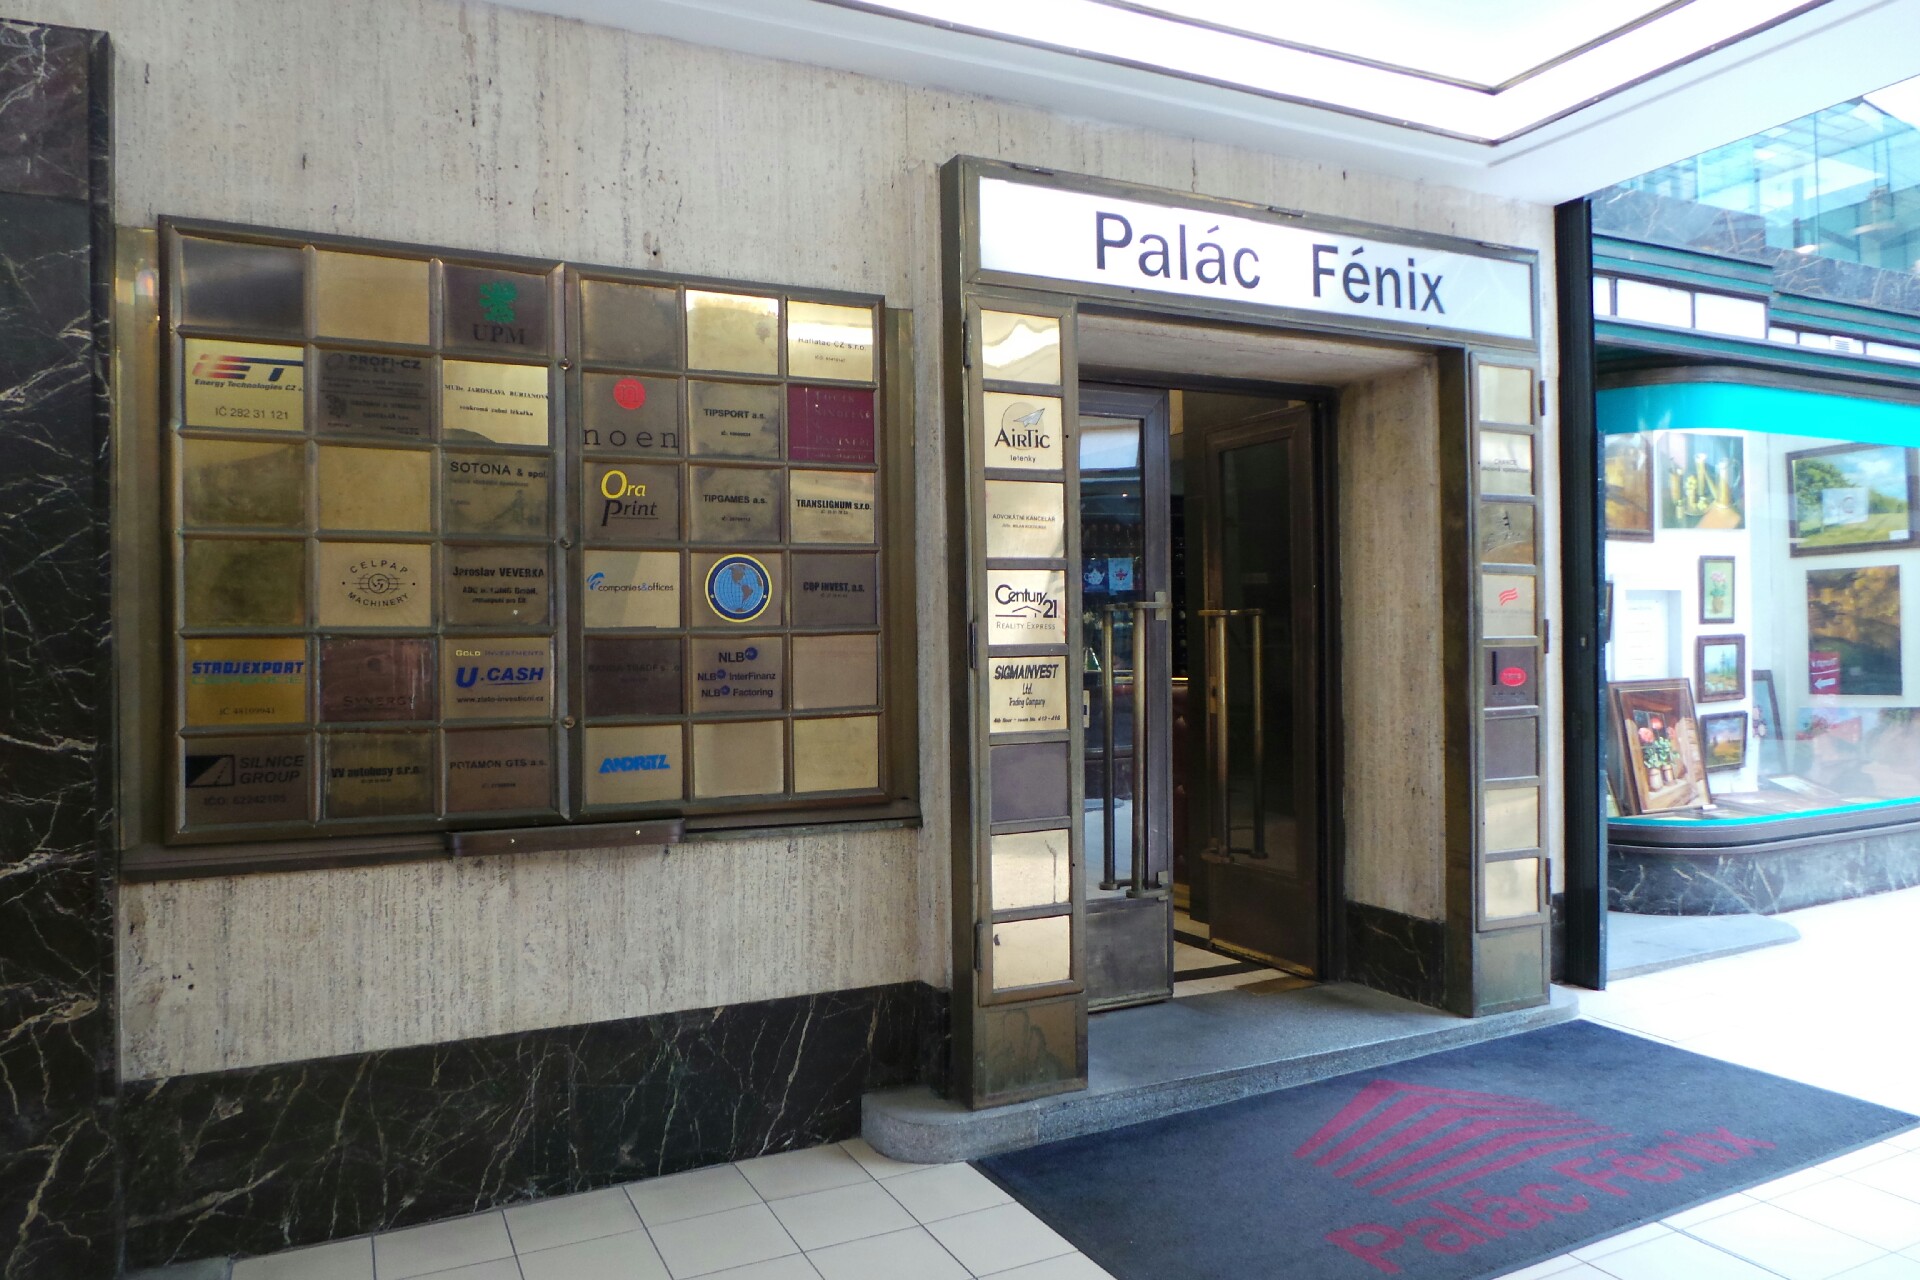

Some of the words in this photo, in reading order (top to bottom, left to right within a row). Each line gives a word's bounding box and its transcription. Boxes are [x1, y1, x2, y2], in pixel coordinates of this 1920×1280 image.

[1095, 211, 1261, 290] Palác
[1312, 244, 1446, 314] Fénix
[472, 323, 526, 345] UPM
[349, 355, 421, 369] PROFI-CZ
[194, 379, 225, 388] Energy
[227, 381, 283, 391] Technologies
[467, 387, 506, 396] JAROSLAVA
[230, 408, 250, 418] 282
[253, 409, 265, 419] 31
[271, 410, 289, 420] 121
[703, 408, 750, 418] TIPSPORT
[583, 428, 679, 449] noen
[1010, 454, 1037, 464] letenky
[450, 461, 511, 475] SOTONA
[516, 468, 523, 477] &
[600, 469, 647, 499] Ora
[703, 494, 750, 503] TIPGAMES
[796, 499, 852, 509] TRANSLIGNUM
[854, 502, 872, 511] s.r.o.
[601, 499, 659, 527] Print
[350, 559, 409, 574] CELPAP
[452, 566, 496, 576] Jaroslav
[499, 567, 544, 578] VEVERKA
[597, 583, 674, 593] companies&offices
[348, 592, 409, 607] MACHINERY
[995, 584, 1048, 605] Century
[1043, 599, 1057, 618] 21
[996, 621, 1024, 629] REALITY
[1027, 622, 1056, 630] EXPRESS
[455, 649, 481, 657] GOLD
[718, 651, 744, 663] NLB
[192, 661, 304, 675] STROJEXPORT
[994, 664, 1059, 680] SIGMAINVEST
[698, 672, 717, 681] NLB
[729, 671, 776, 681] InterFinanz
[701, 688, 720, 697] NLB
[732, 687, 773, 698] Factoring
[1022, 683, 1033, 695] Ltd.
[1009, 697, 1024, 708] Trading
[1025, 697, 1046, 708] Company
[239, 755, 304, 768] SILNICE
[449, 760, 501, 770] POTAMON
[505, 759, 527, 768] GTS
[598, 754, 671, 774] ANDRITZ
[240, 771, 300, 784] GROUP
[347, 766, 393, 778] autobusy
[1325, 1182, 1590, 1274] Palác
[1551, 1126, 1777, 1197] Fénix
